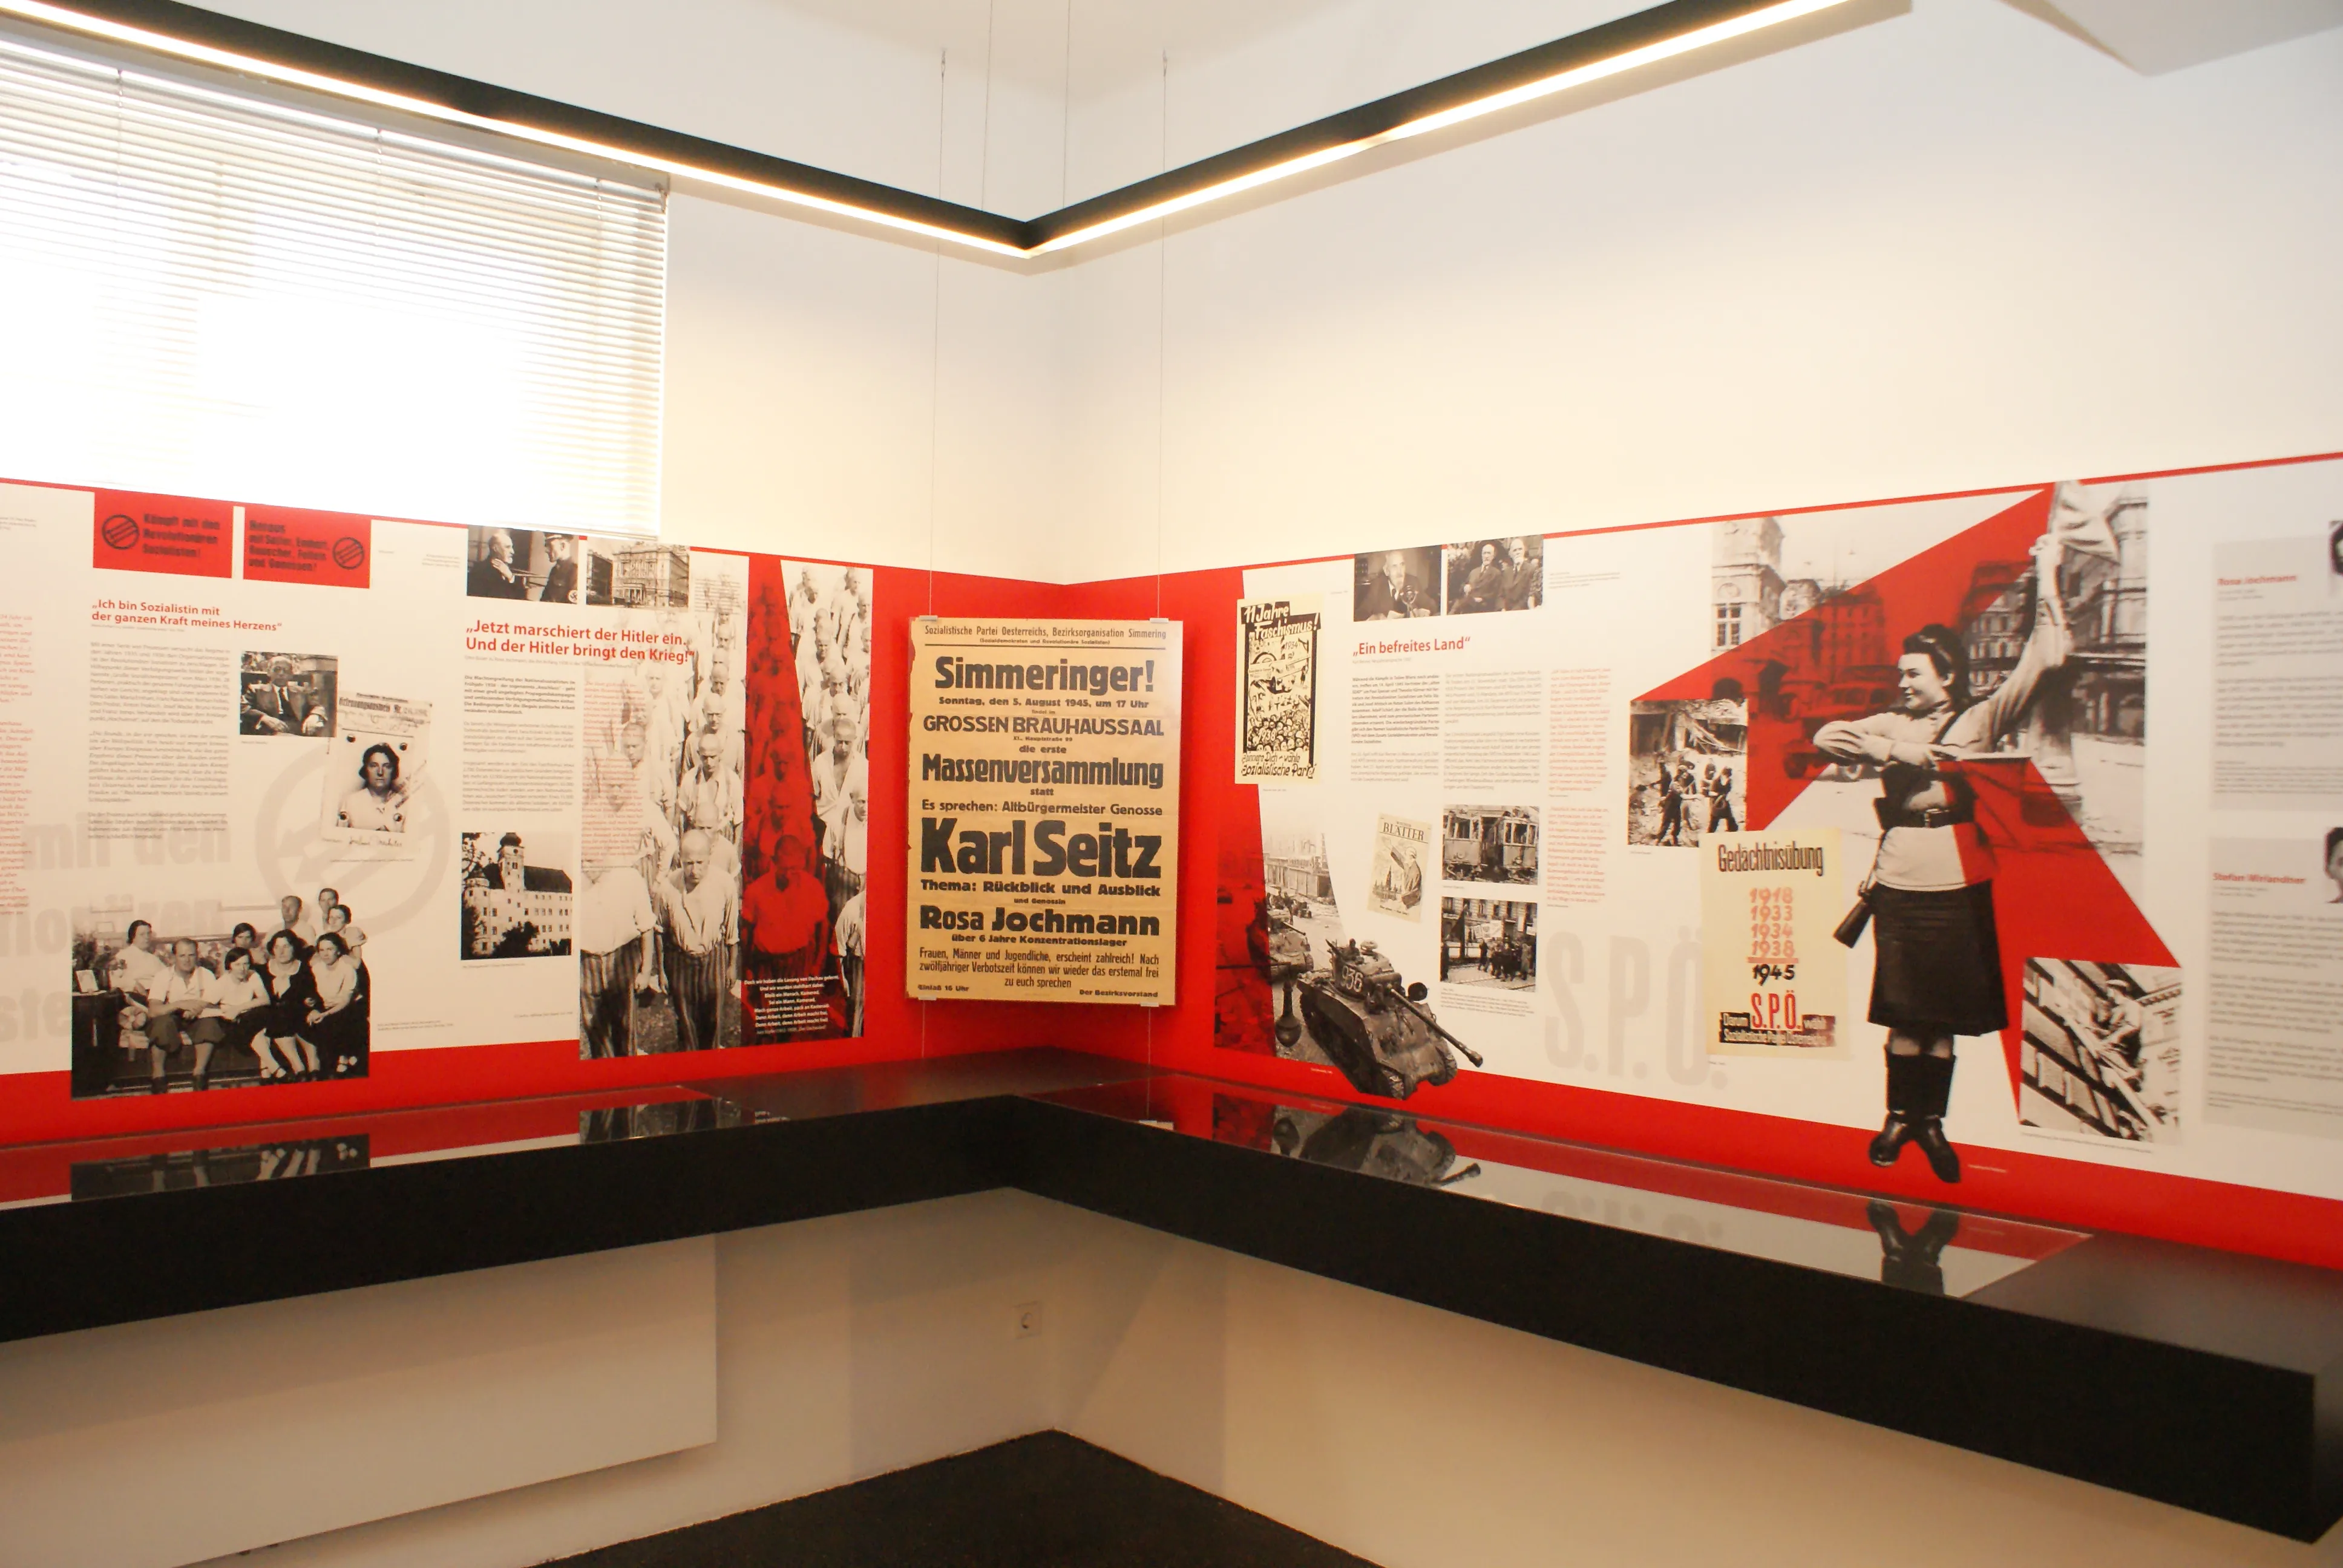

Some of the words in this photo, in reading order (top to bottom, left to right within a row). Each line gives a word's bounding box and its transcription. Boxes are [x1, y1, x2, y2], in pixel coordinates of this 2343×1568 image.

[119, 600, 137, 610] bin
[140, 602, 198, 615] Sozialistin
[202, 607, 220, 616] mit
[1256, 603, 1289, 622] Jahre
[92, 612, 111, 621] der
[115, 615, 157, 624] ganzen
[160, 616, 188, 626] Kraft
[191, 618, 231, 628] meines
[1254, 613, 1320, 639] Faschismus!
[467, 619, 510, 635] „Jetzt
[514, 624, 591, 639] marschiert
[594, 629, 618, 641] der
[621, 630, 658, 644] Hitler
[663, 633, 687, 645] ein.
[925, 626, 972, 635] Sozialistische
[977, 626, 998, 636] Partei
[1001, 627, 1049, 638] Oesterreichs,
[1052, 627, 1124, 639] Bezirksorganisation
[1128, 629, 1166, 639] Simmering
[466, 636, 496, 651] Und
[501, 639, 525, 653] der
[529, 641, 569, 655] Hitler
[574, 643, 616, 661] bringt
[620, 646, 645, 659] den
[1352, 642, 1375, 657] „Ein
[1379, 639, 1431, 653] befreites
[1434, 636, 1471, 651] Land“
[935, 656, 1155, 696] Simmeringer!
[939, 697, 985, 707] Sonntag,
[1025, 698, 1061, 708] August
[1065, 699, 1092, 708] 1945,
[1130, 700, 1149, 708] Uhr
[923, 716, 1008, 733] GROSSEN
[1012, 717, 1164, 737] BRAUHAUSSAAL
[1019, 745, 1036, 754] die
[1040, 745, 1066, 754] erste
[922, 754, 1164, 789] Massenversammlung
[1030, 788, 1054, 796] statt
[922, 799, 936, 811] Es
[940, 799, 998, 814] sprechen:
[1001, 802, 1106, 815] Altbürgermeister
[1110, 804, 1162, 816] Genosse
[920, 817, 1026, 875] Karl
[1033, 820, 1162, 878] Seitz
[920, 879, 977, 892] Thema:
[983, 881, 1055, 894] Rückblick
[1062, 884, 1092, 895] und
[1098, 884, 1161, 897] Ausblick
[920, 905, 984, 930] Rosa
[992, 907, 1159, 936] Jochmann
[1750, 905, 1793, 923] 1933
[1751, 923, 1793, 940] 1934
[1020, 936, 1127, 947] Konzentrationslager
[1751, 939, 1795, 957] 1938
[919, 947, 948, 959] Frauen,
[952, 948, 981, 960] Männer
[986, 950, 1000, 961] und
[1004, 950, 1051, 962] Jugendliche,
[1056, 952, 1092, 964] erscheint
[1096, 953, 1135, 964] zahlreich!
[1140, 953, 1159, 964] Nach
[919, 961, 969, 975] zwölfjähriger
[972, 962, 1015, 974] Verbotszeit
[1017, 963, 1045, 975] können
[1048, 964, 1060, 974] wir
[1063, 964, 1089, 976] wieder
[1092, 965, 1106, 976] das
[1109, 966, 1142, 977] erstemal
[1145, 967, 1159, 978] frei
[1340, 965, 1363, 992] 936
[1752, 963, 1795, 986] 1945
[1004, 978, 1017, 987] zu
[1019, 976, 1034, 987] euch
[1037, 977, 1072, 988] sprechen
[1751, 990, 1801, 1030] S.P.Ö.
